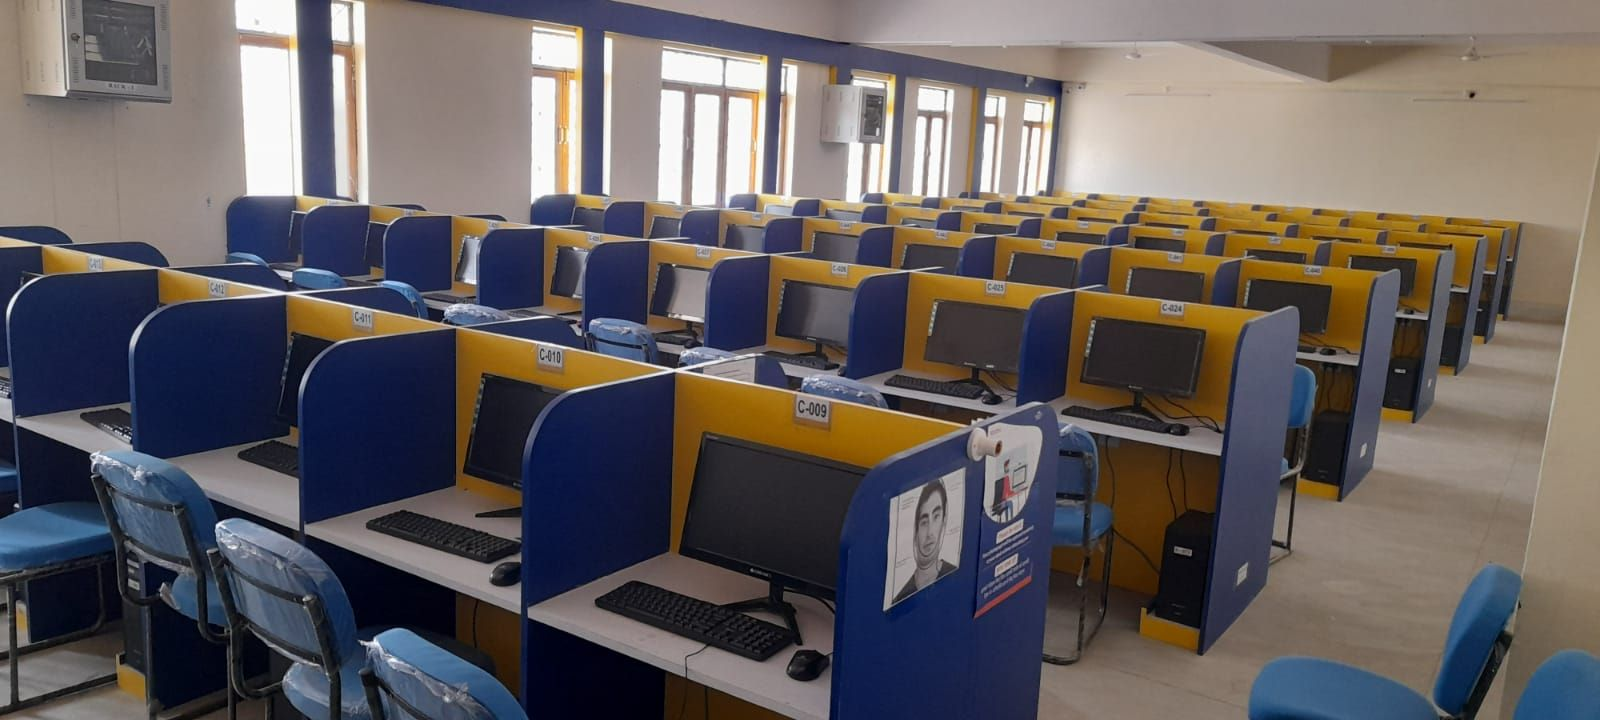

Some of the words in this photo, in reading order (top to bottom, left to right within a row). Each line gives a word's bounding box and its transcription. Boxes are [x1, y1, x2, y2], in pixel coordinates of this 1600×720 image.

[210, 282, 225, 295] C-012
[1162, 303, 1182, 313] C-024
[354, 311, 372, 324] C-011
[539, 348, 561, 364] C-010
[797, 400, 827, 418] C-009
